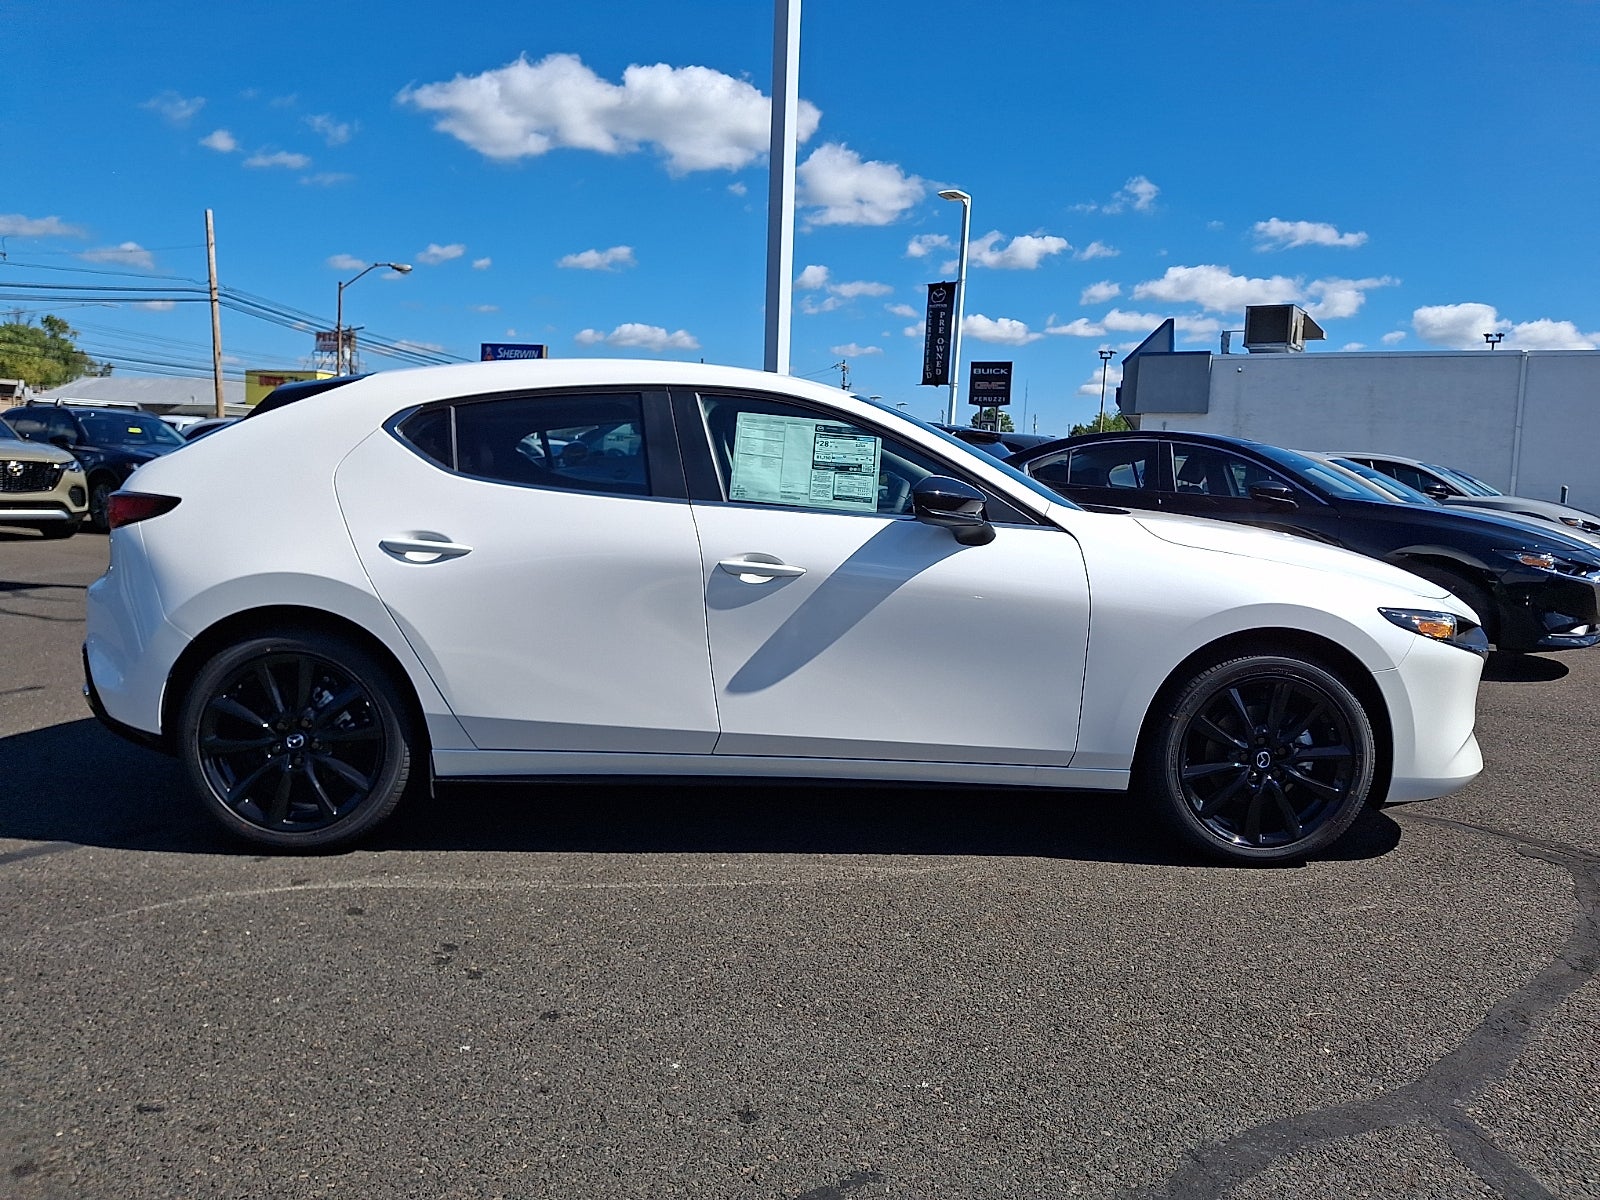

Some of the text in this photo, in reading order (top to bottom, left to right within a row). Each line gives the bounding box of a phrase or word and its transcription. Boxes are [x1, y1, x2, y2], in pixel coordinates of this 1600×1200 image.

[938, 311, 946, 334] PRE
[496, 346, 539, 359] SHERWIN
[935, 337, 945, 375] OWNED
[974, 381, 1006, 390] GMC
[819, 440, 830, 448] 28
